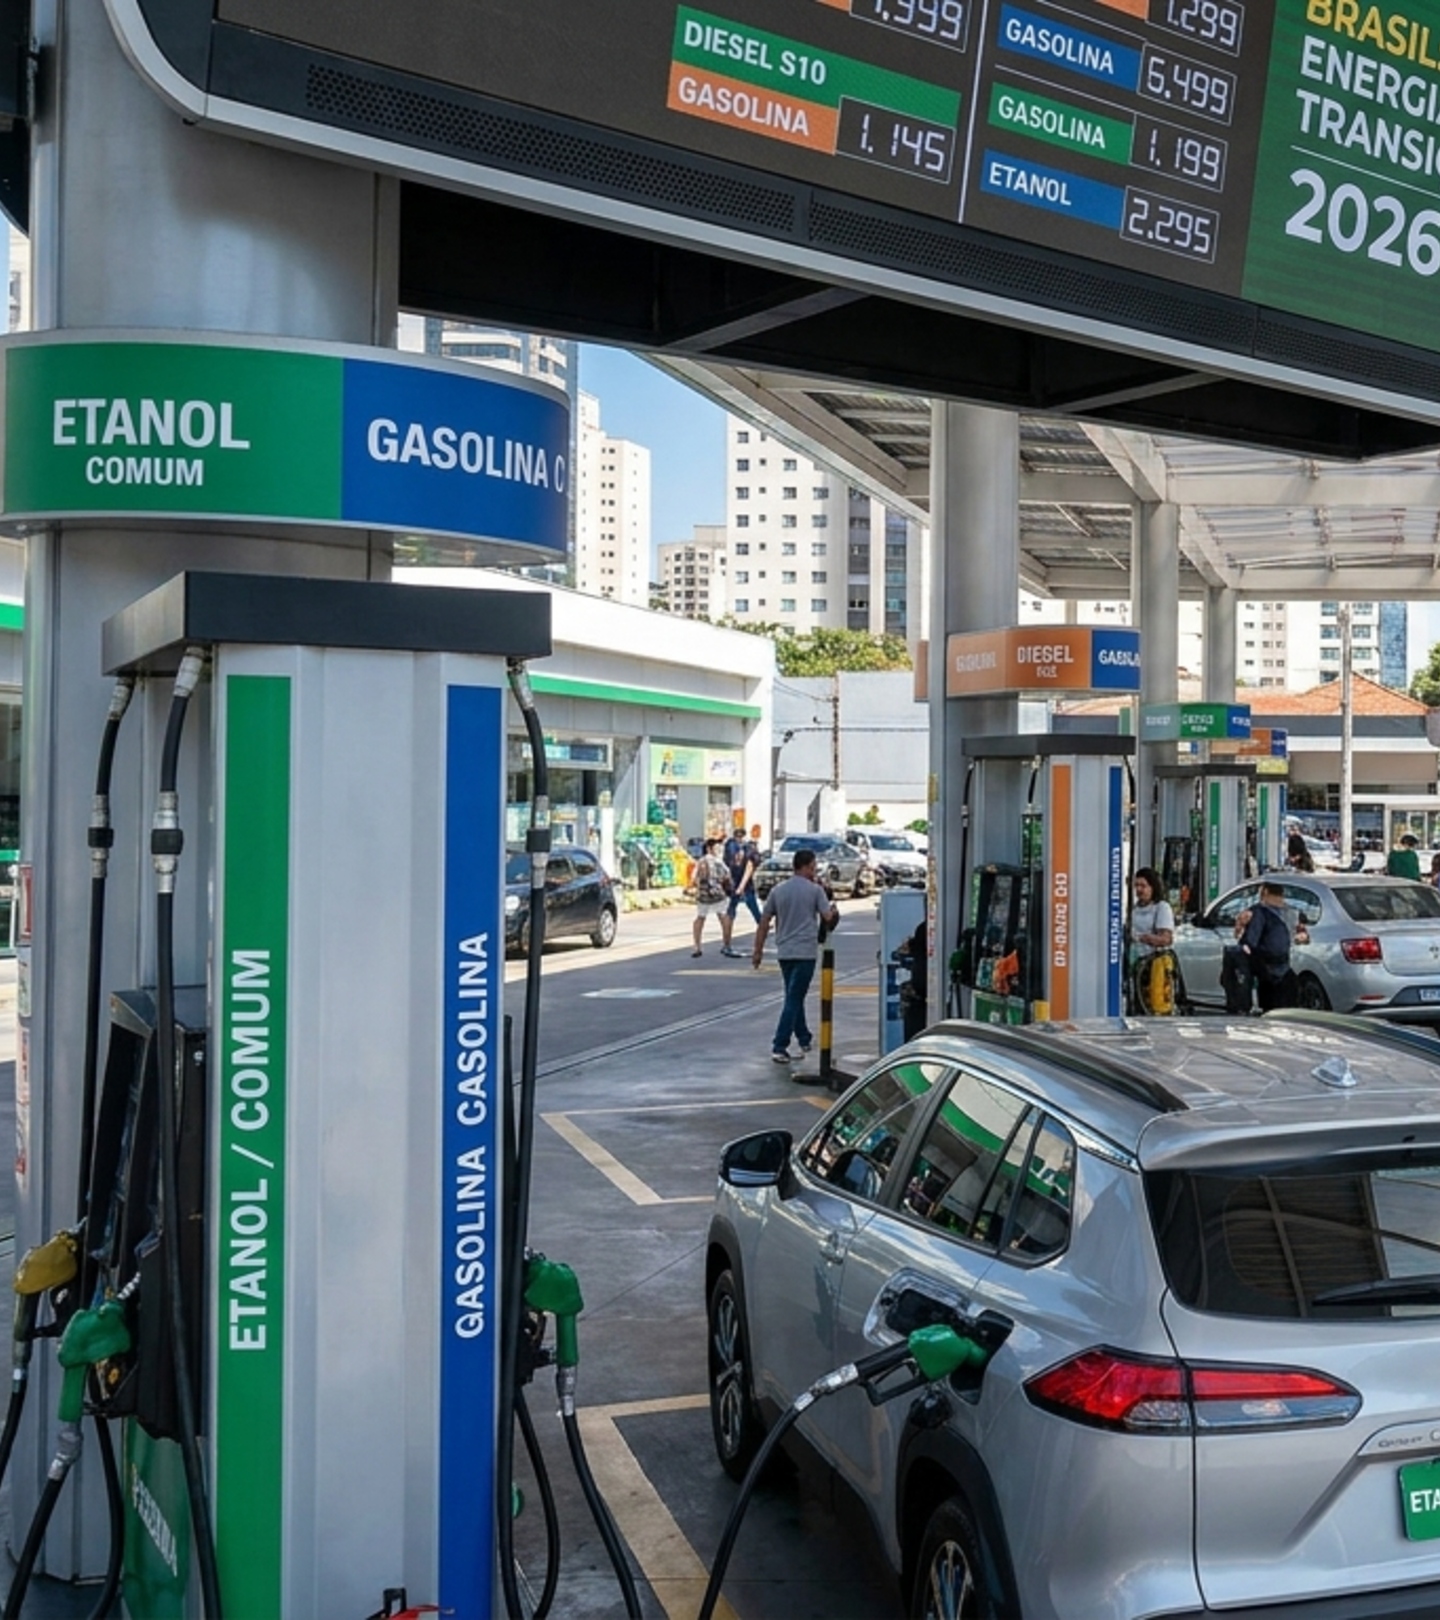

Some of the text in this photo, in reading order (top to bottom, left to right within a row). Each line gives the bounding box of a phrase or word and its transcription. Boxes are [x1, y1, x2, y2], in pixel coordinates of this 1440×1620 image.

[683, 20, 827, 86] DIESEL S10
[1005, 18, 1228, 115] GASOLINA 6.499
[678, 77, 945, 172] GASOLINA 1.145
[998, 95, 1220, 182] GASOLINA 1.199
[989, 161, 1211, 254] ETANOL 2.295
[53, 398, 250, 450] ETANOL
[367, 417, 549, 489] GASOLINA
[86, 456, 203, 486] COMUM
[231, 950, 270, 1131] COMUM
[229, 1178, 268, 1350] ETANOL
[455, 1146, 486, 1339] GASOLINA
